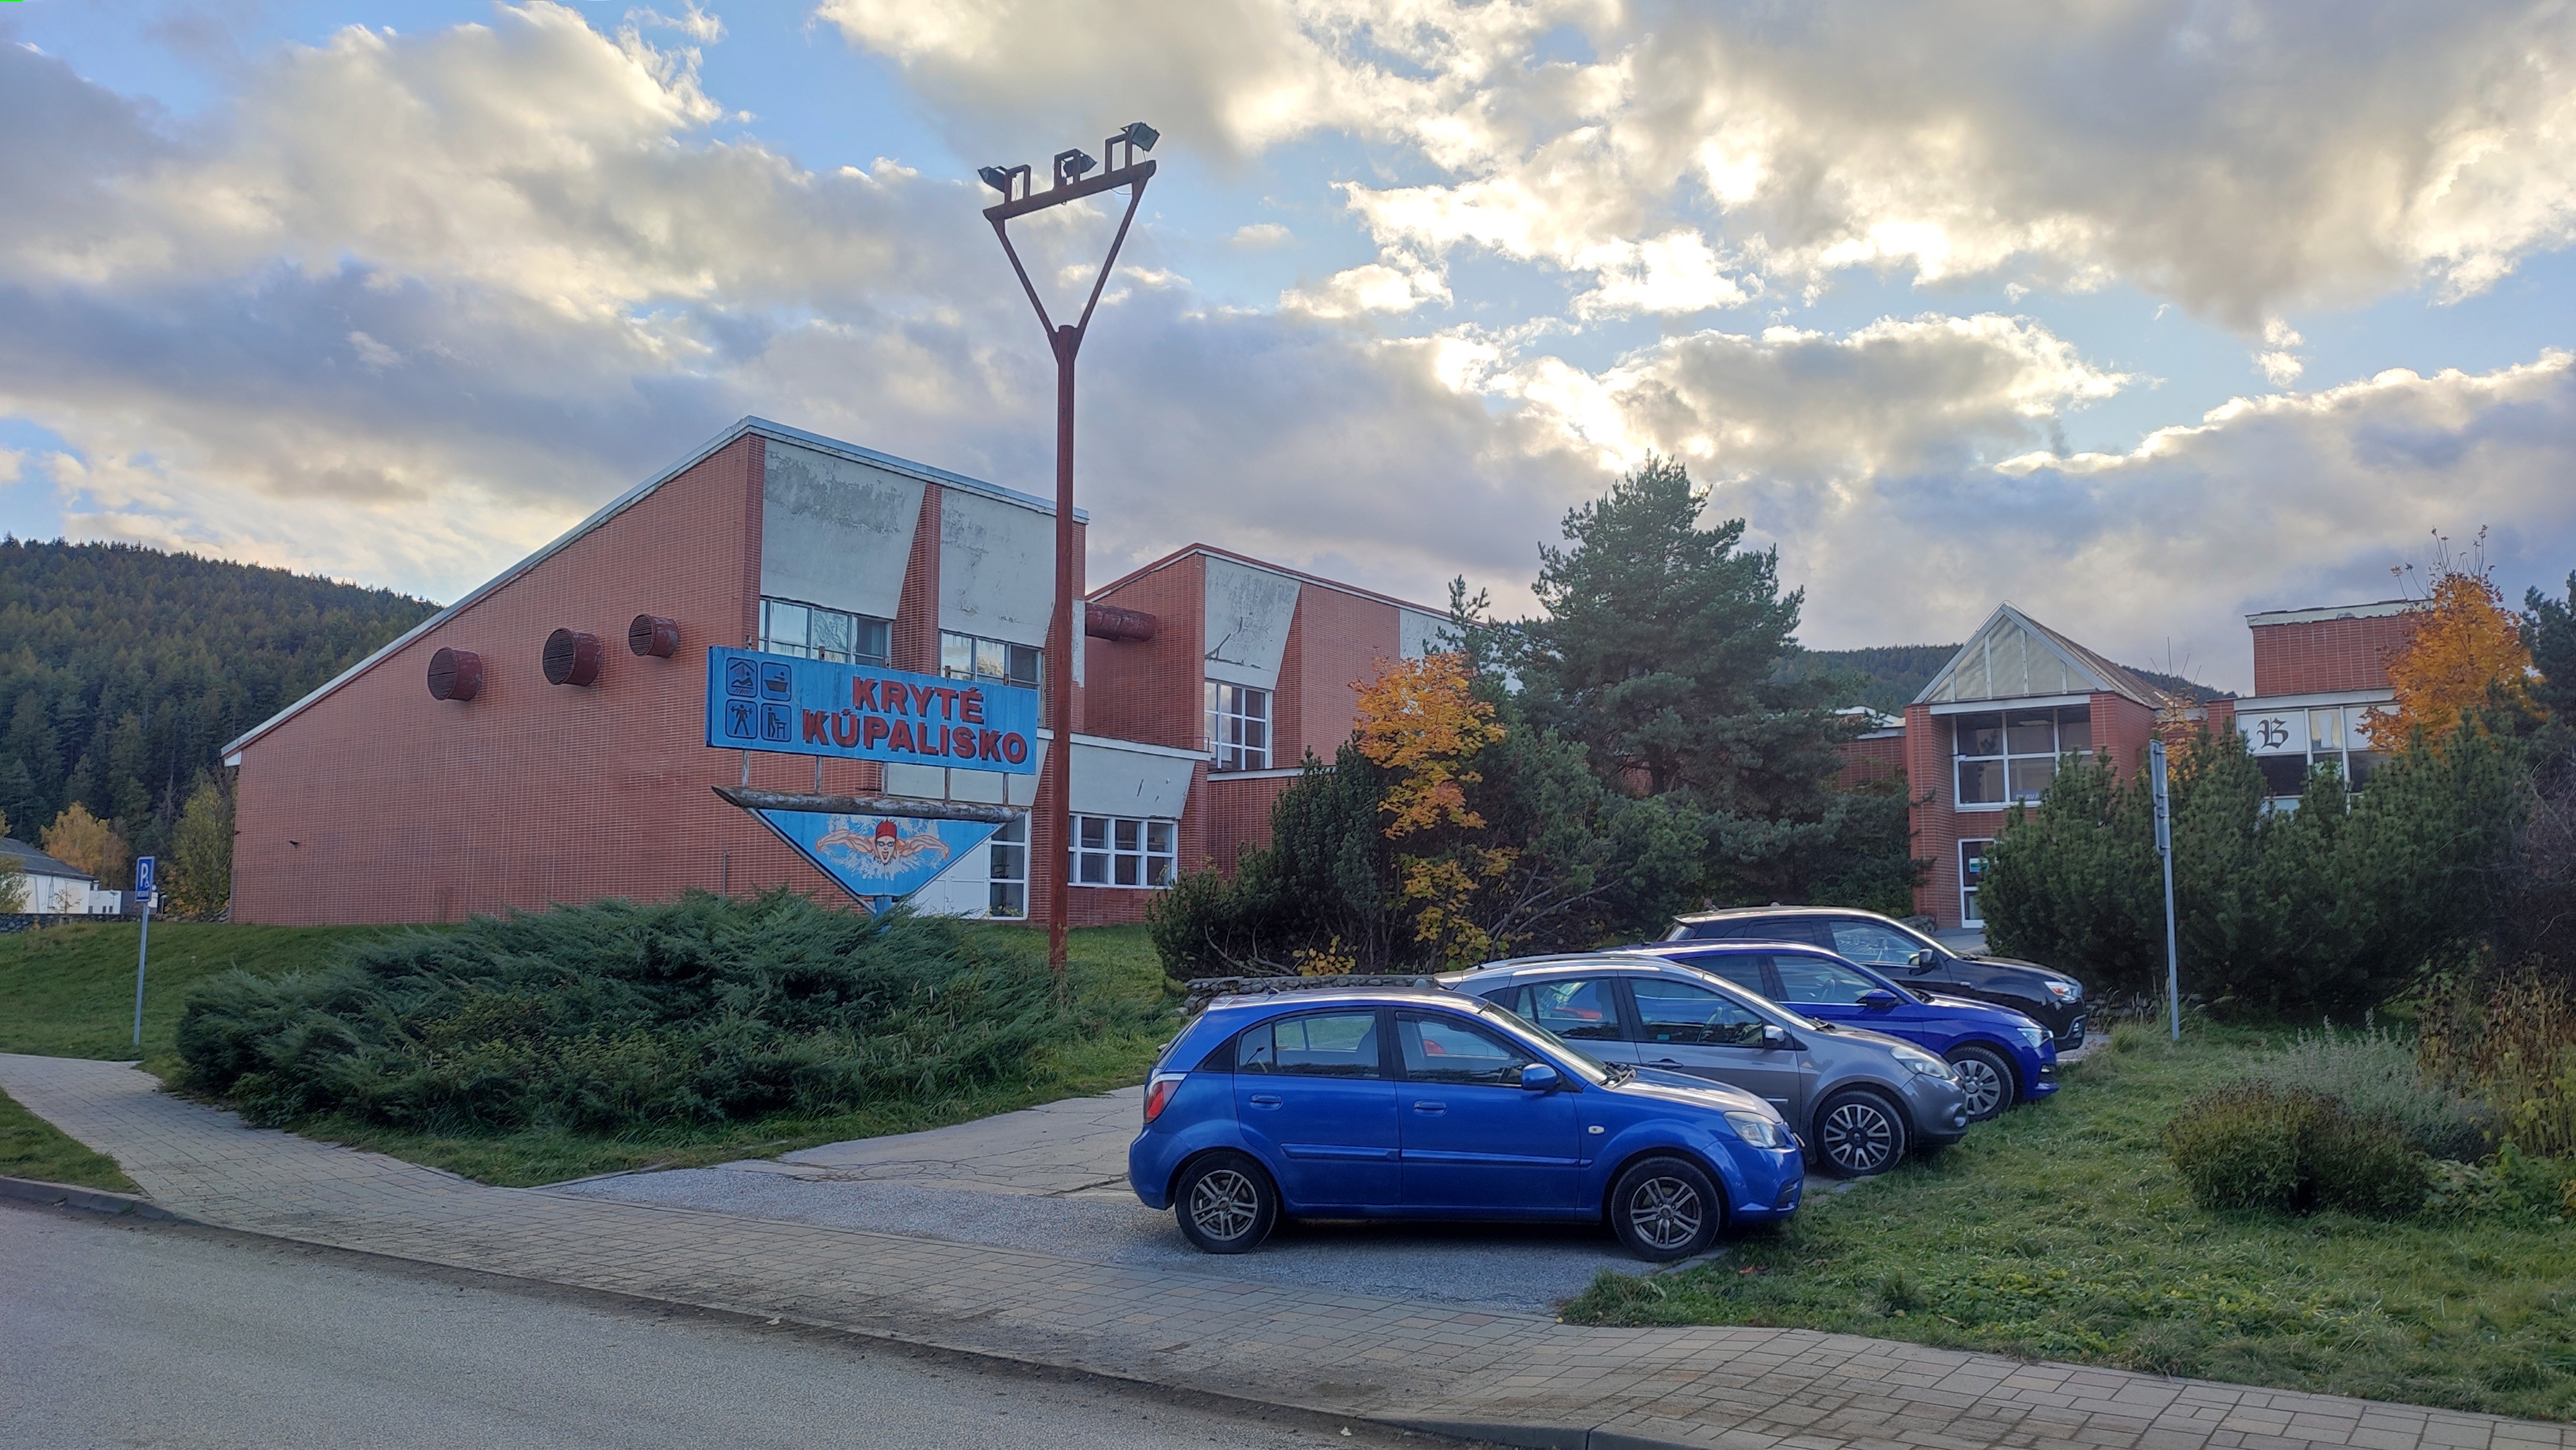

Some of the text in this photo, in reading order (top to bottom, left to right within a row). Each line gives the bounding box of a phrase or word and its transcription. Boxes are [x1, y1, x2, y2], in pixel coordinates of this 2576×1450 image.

[853, 676, 984, 724] KRYTÉ
[802, 709, 1027, 764] KÚPALISKO
[2257, 717, 2289, 749] B
[140, 863, 149, 887] P
